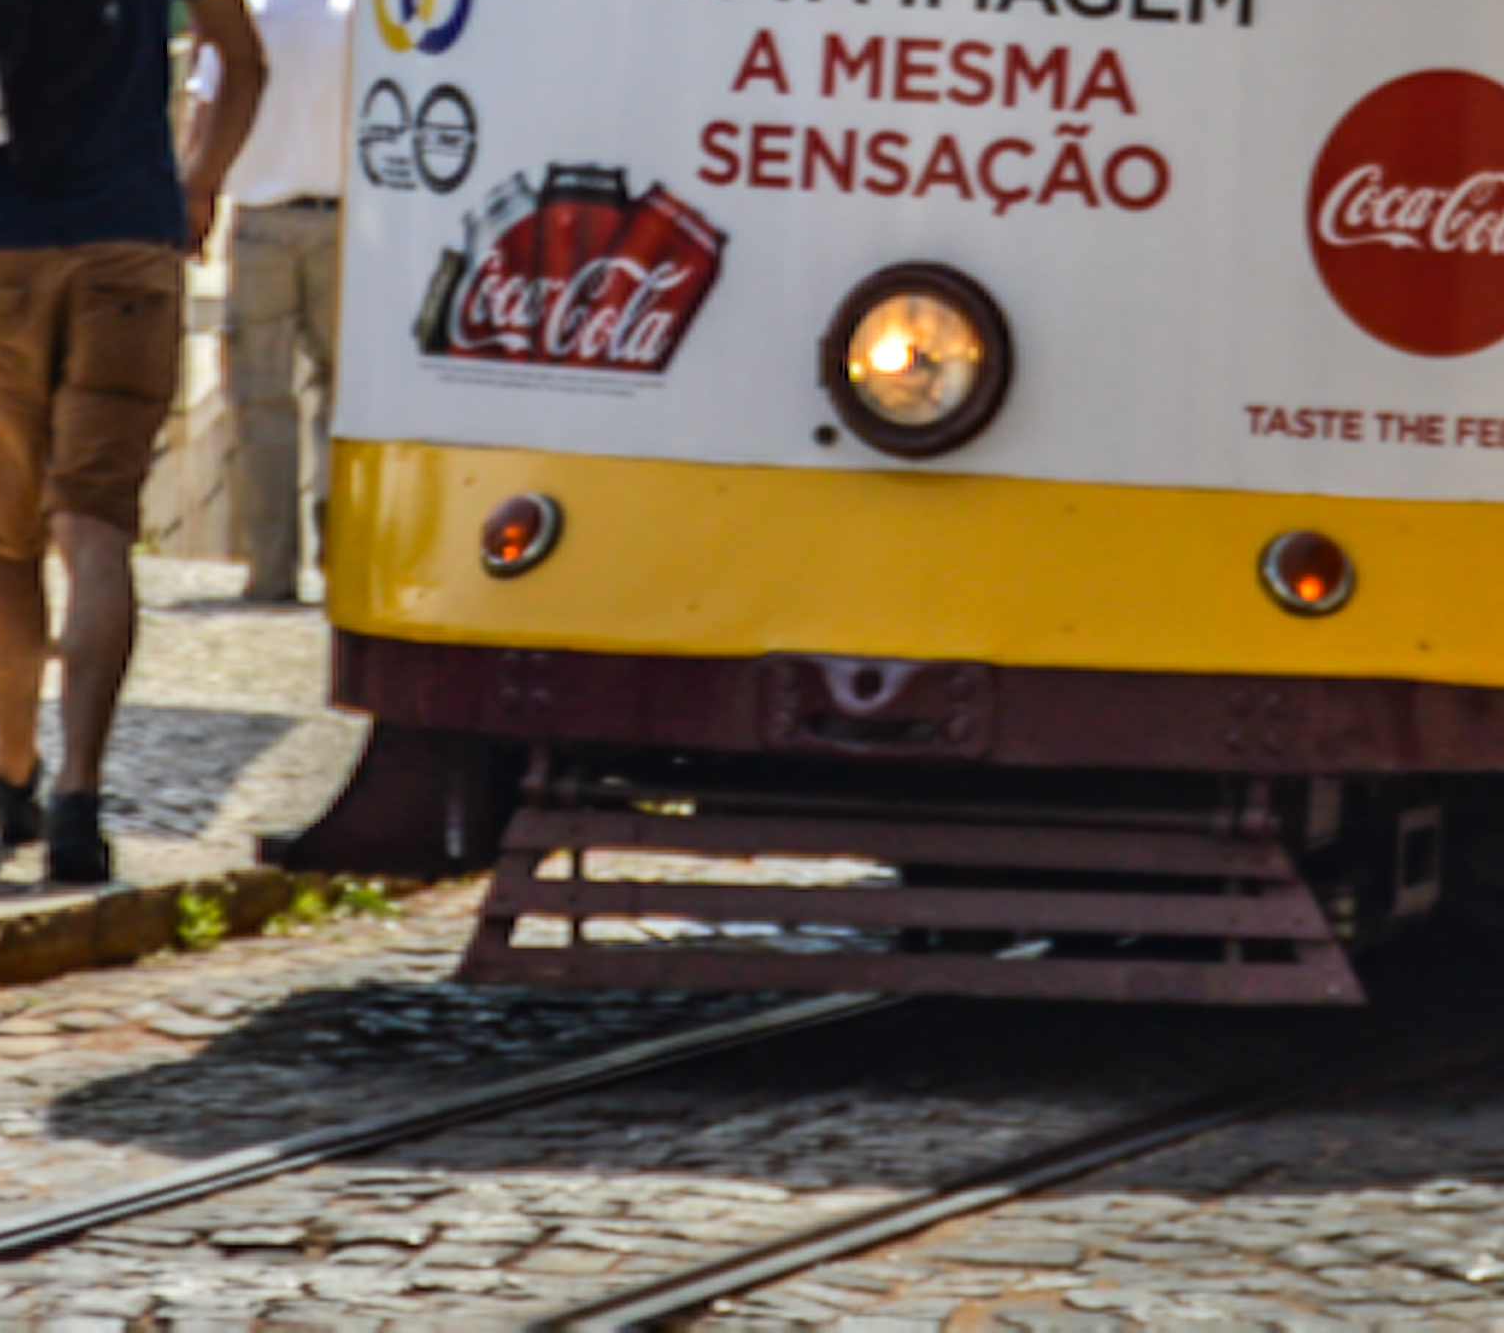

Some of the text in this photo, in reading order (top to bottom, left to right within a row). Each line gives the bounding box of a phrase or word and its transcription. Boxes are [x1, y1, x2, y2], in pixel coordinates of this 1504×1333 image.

[730, 27, 1139, 117] A MESMA
[696, 119, 1173, 217] SENSAÇÃO
[447, 248, 696, 363] Coca-Cola
[1243, 403, 1364, 442] TASTE
[1374, 409, 1446, 447] THE
